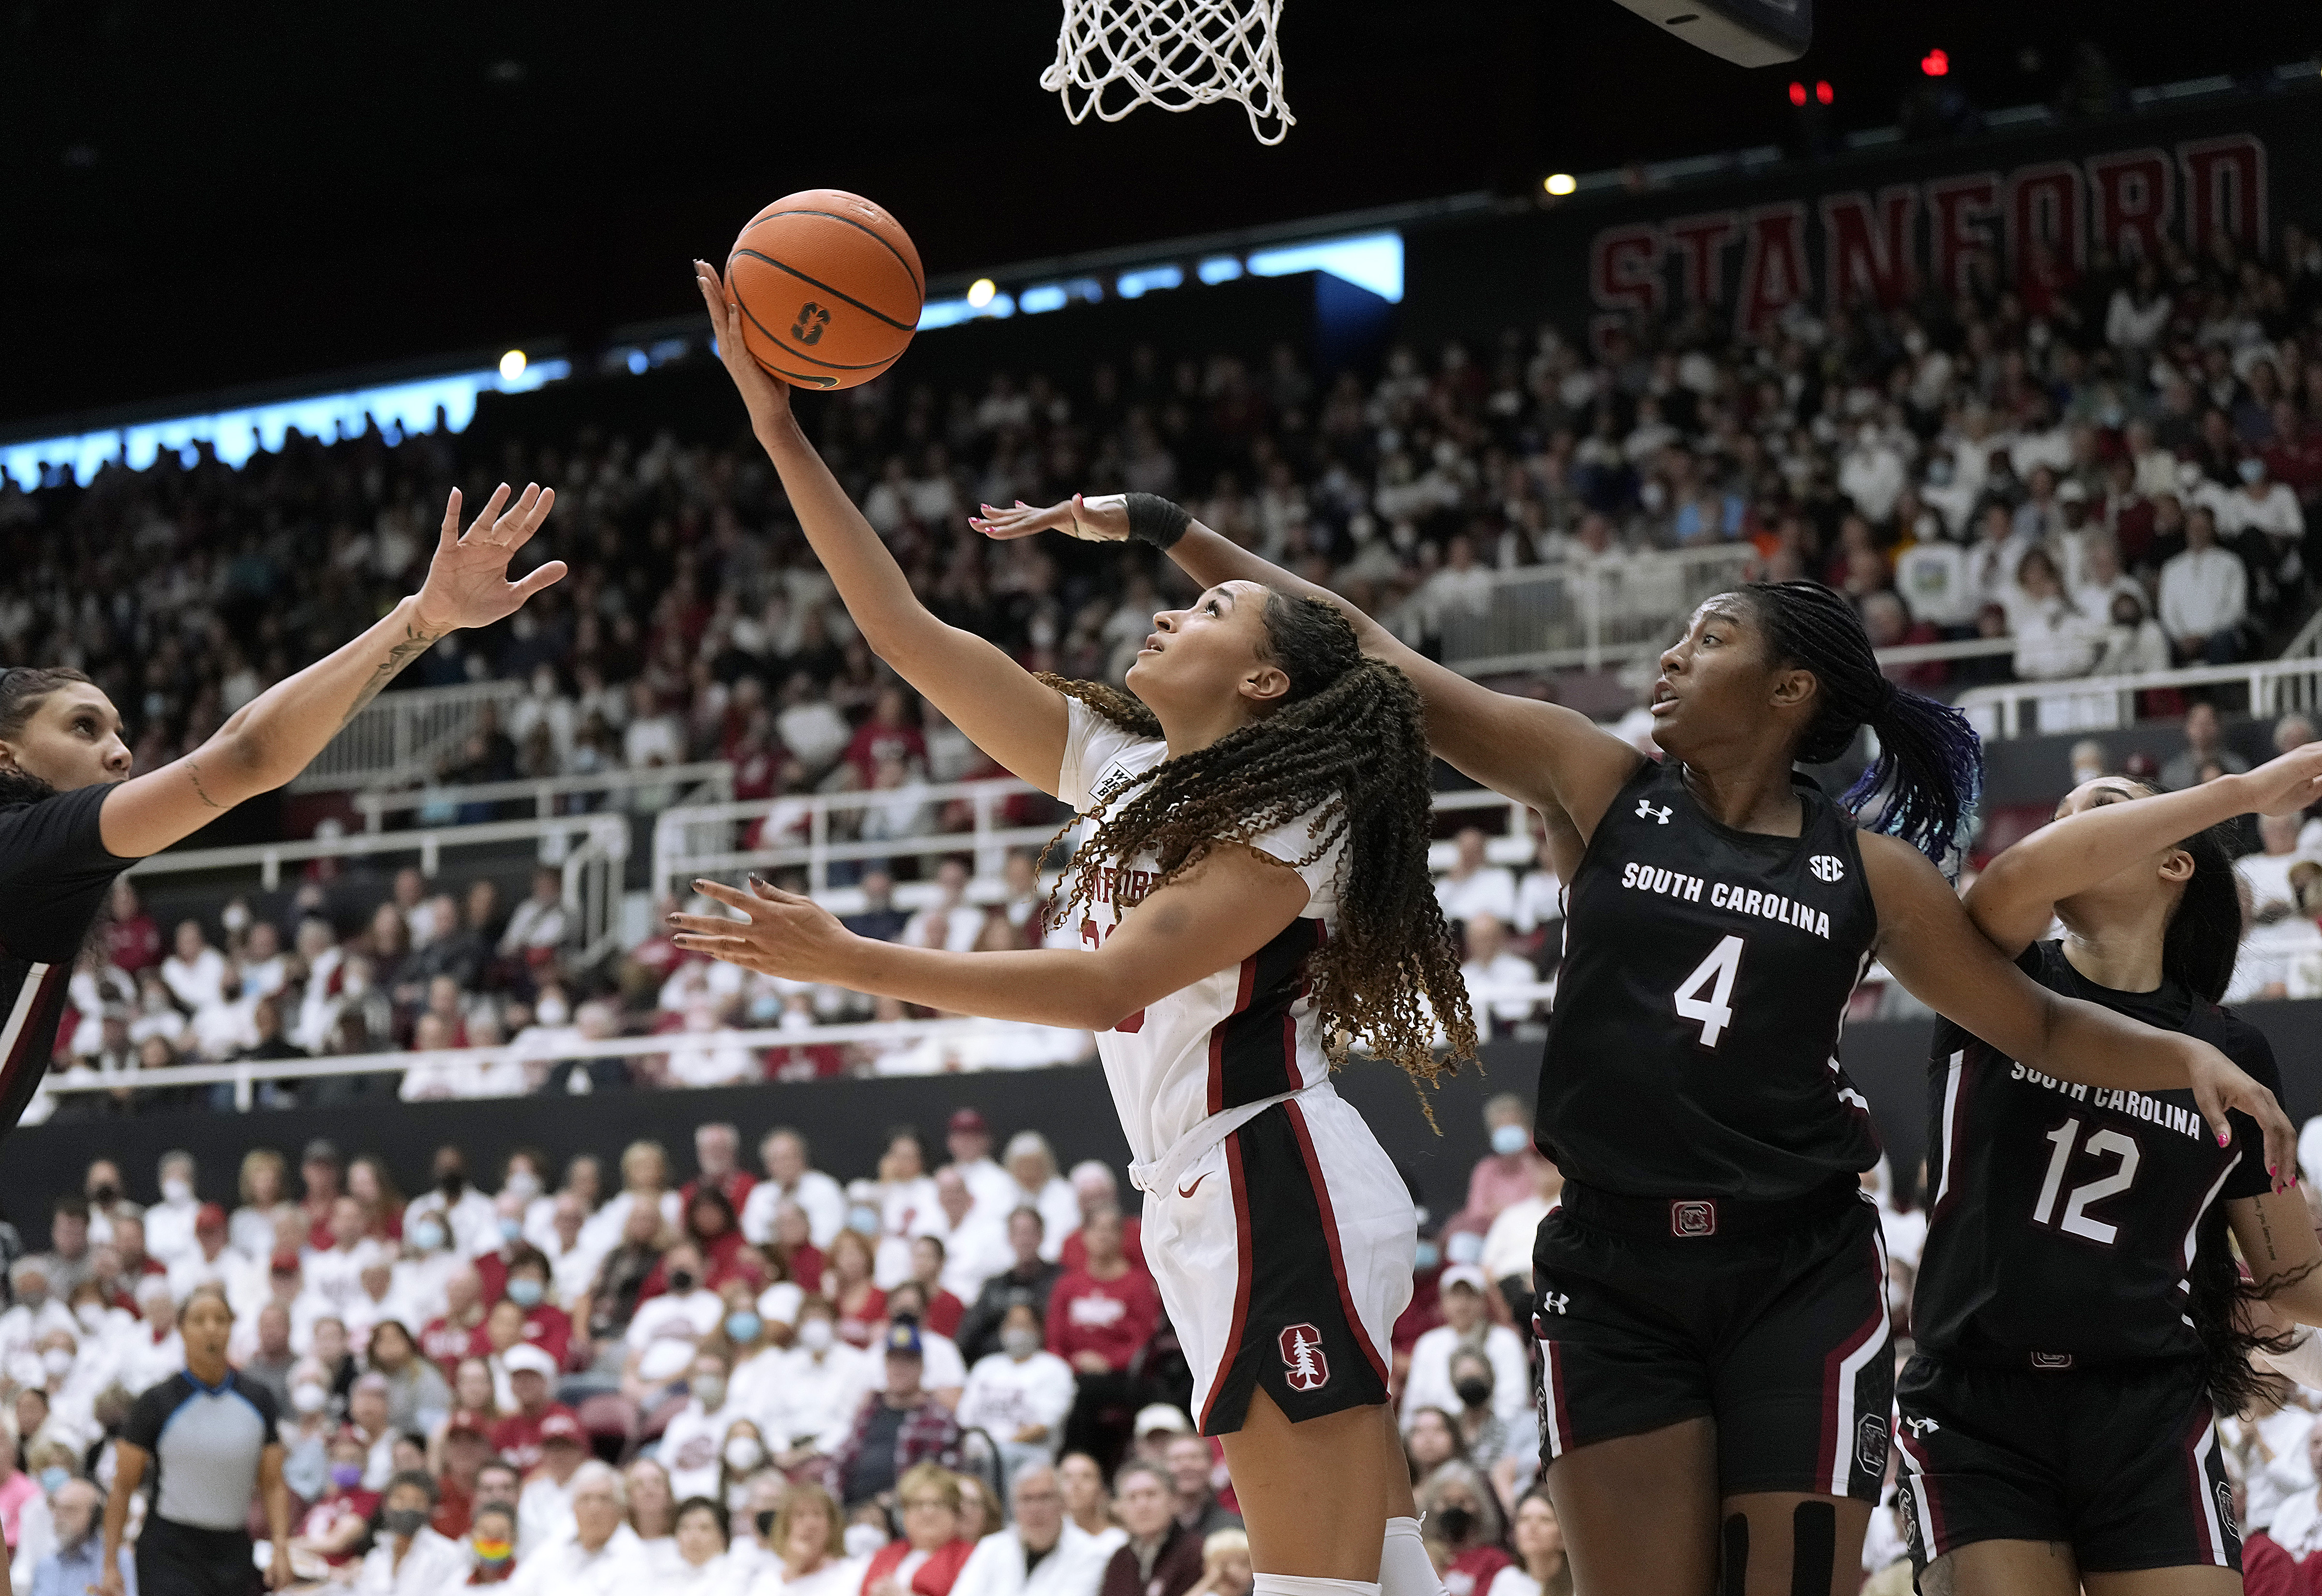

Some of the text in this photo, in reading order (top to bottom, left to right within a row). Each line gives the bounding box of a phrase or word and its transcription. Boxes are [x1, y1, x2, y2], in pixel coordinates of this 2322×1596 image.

[1622, 862, 1830, 940] SOUTH CAROLINA
[1809, 855, 1844, 882] SEC
[1673, 934, 1744, 1048] 4
[2094, 1087, 2201, 1141] CAROLINA
[2033, 1117, 2141, 1244] 12
